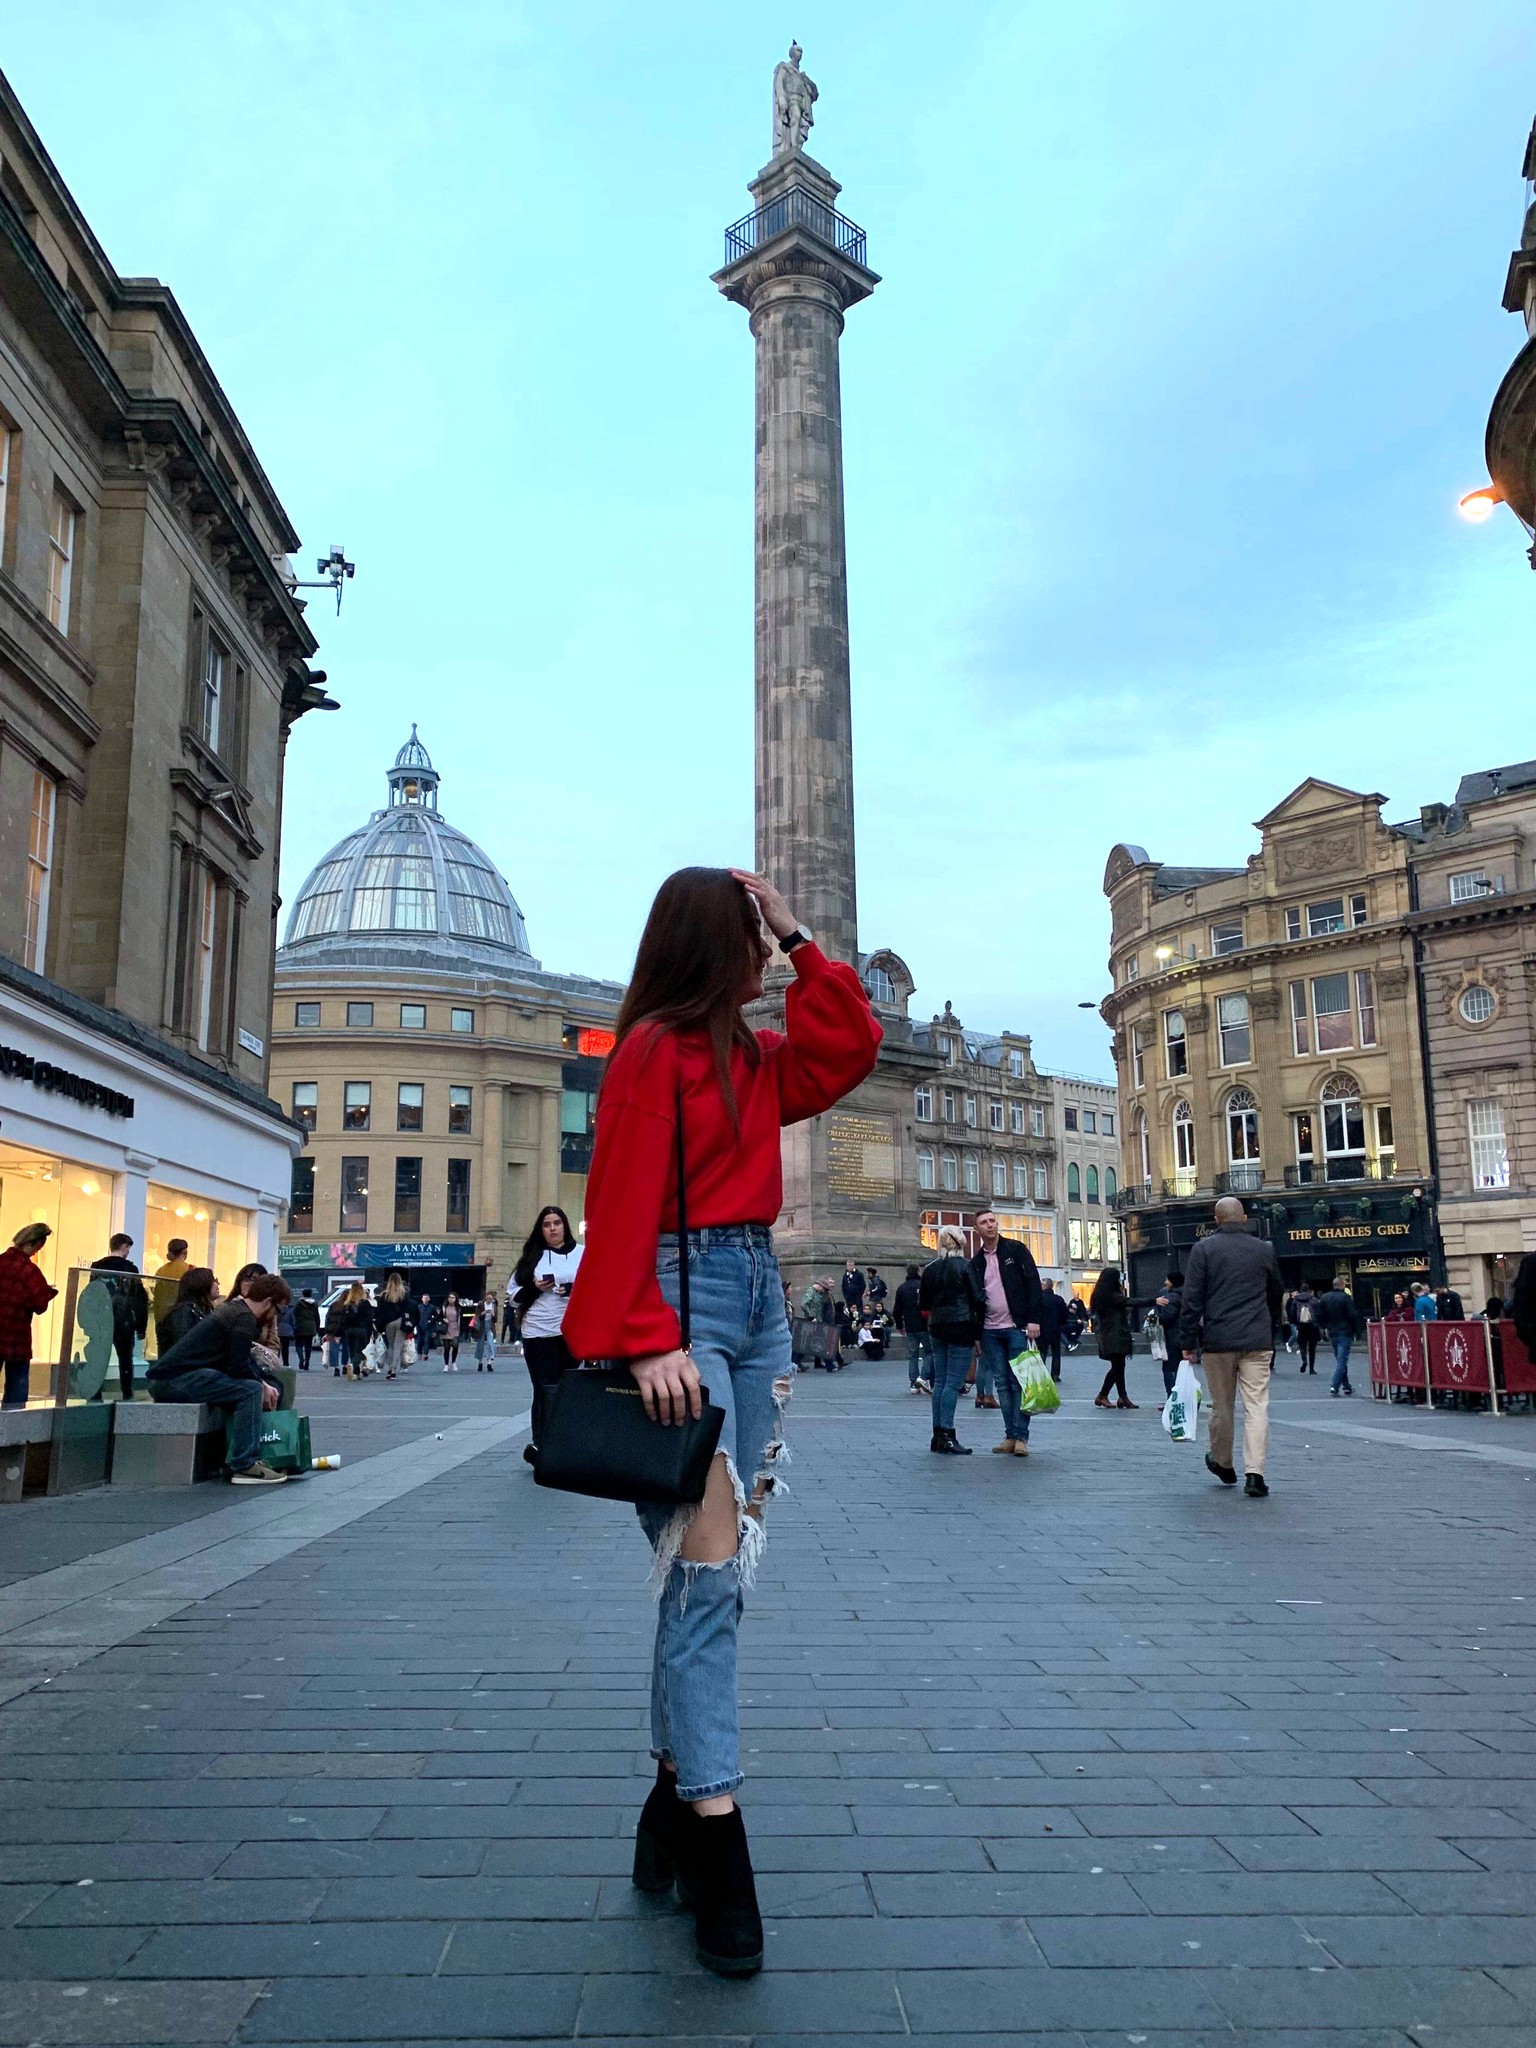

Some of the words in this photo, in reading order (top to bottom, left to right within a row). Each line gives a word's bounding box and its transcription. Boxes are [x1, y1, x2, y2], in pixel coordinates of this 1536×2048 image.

[1288, 1229, 1312, 1241] THE
[1317, 1226, 1372, 1239] CHARLES
[1377, 1223, 1411, 1236] GREY
[307, 1248, 324, 1256] DAY
[395, 1244, 442, 1252] BANYAN
[1358, 1257, 1431, 1268] BASEMENT
